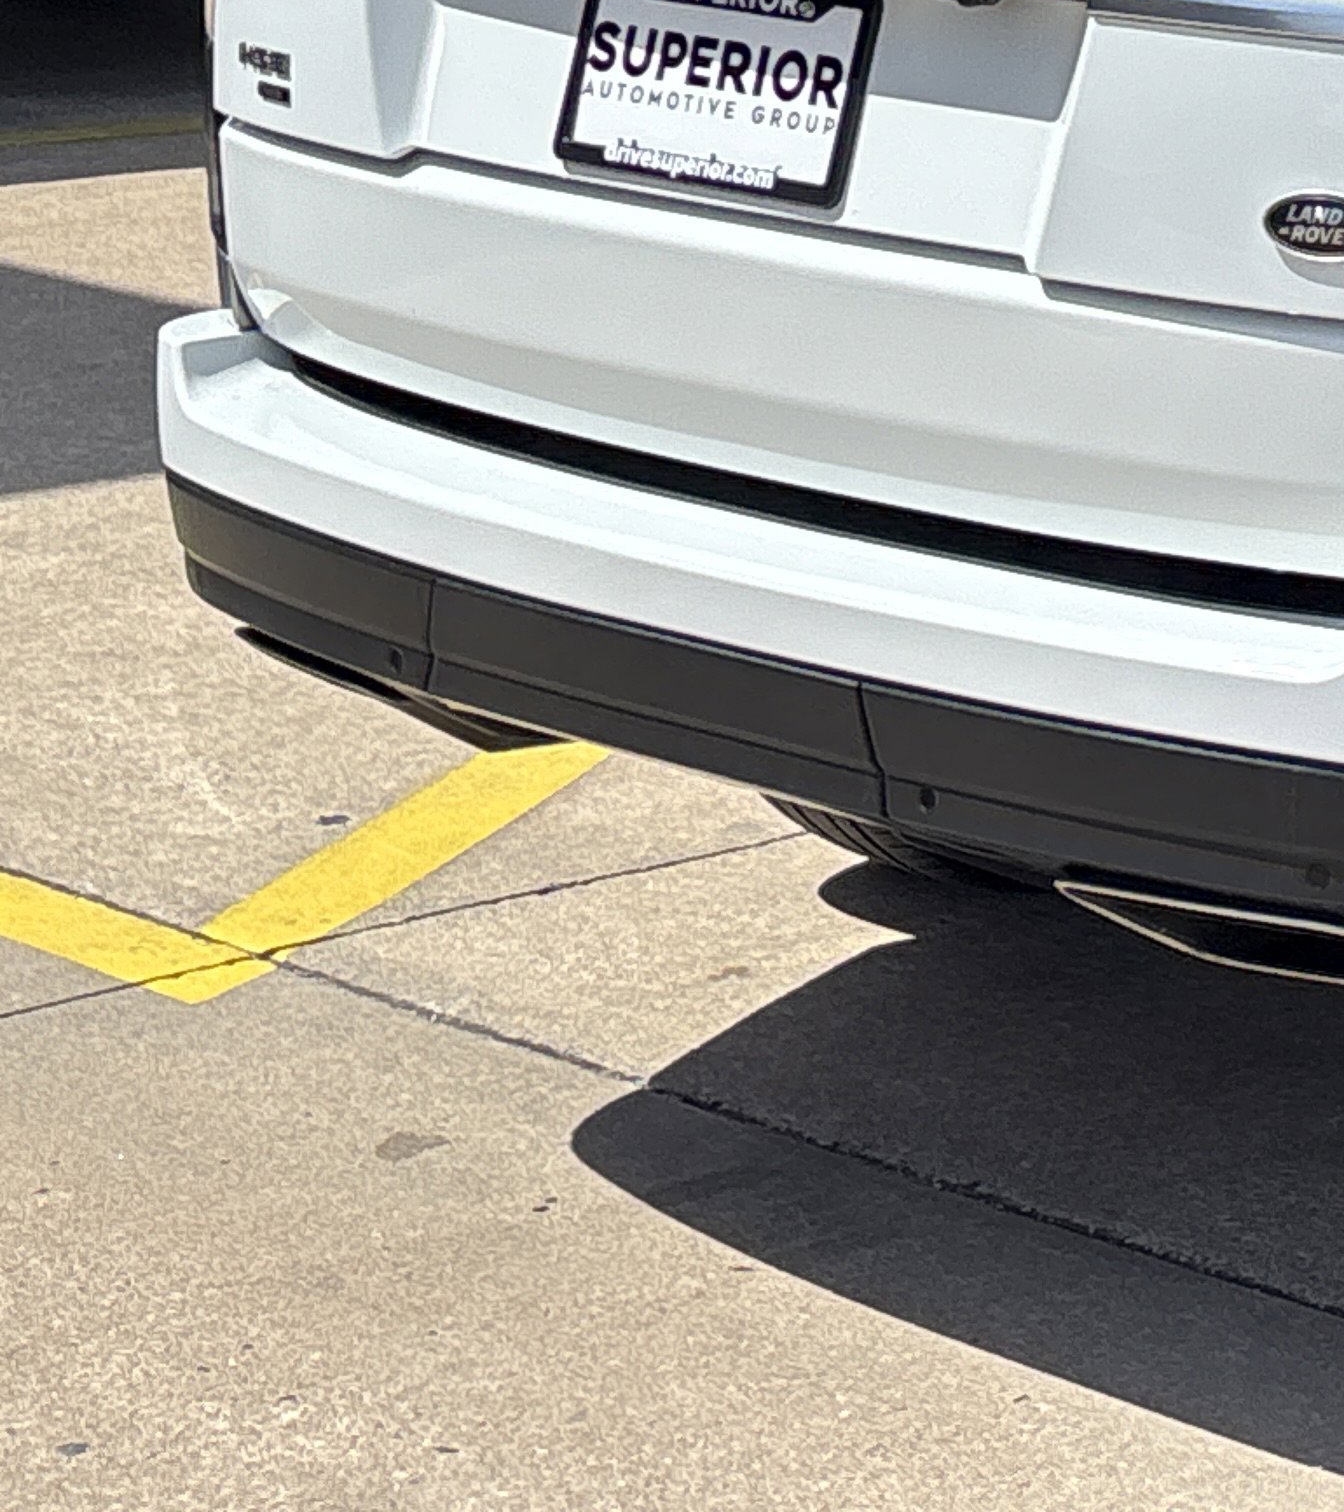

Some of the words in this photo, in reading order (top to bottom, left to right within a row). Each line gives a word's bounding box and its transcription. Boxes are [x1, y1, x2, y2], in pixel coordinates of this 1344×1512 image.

[587, 20, 843, 110] SUPERIOR
[582, 79, 736, 119] AUTOMOTIVE
[752, 105, 835, 134] GROUP
[603, 140, 774, 189] drivesuperior.com
[1286, 203, 1344, 226] LAND
